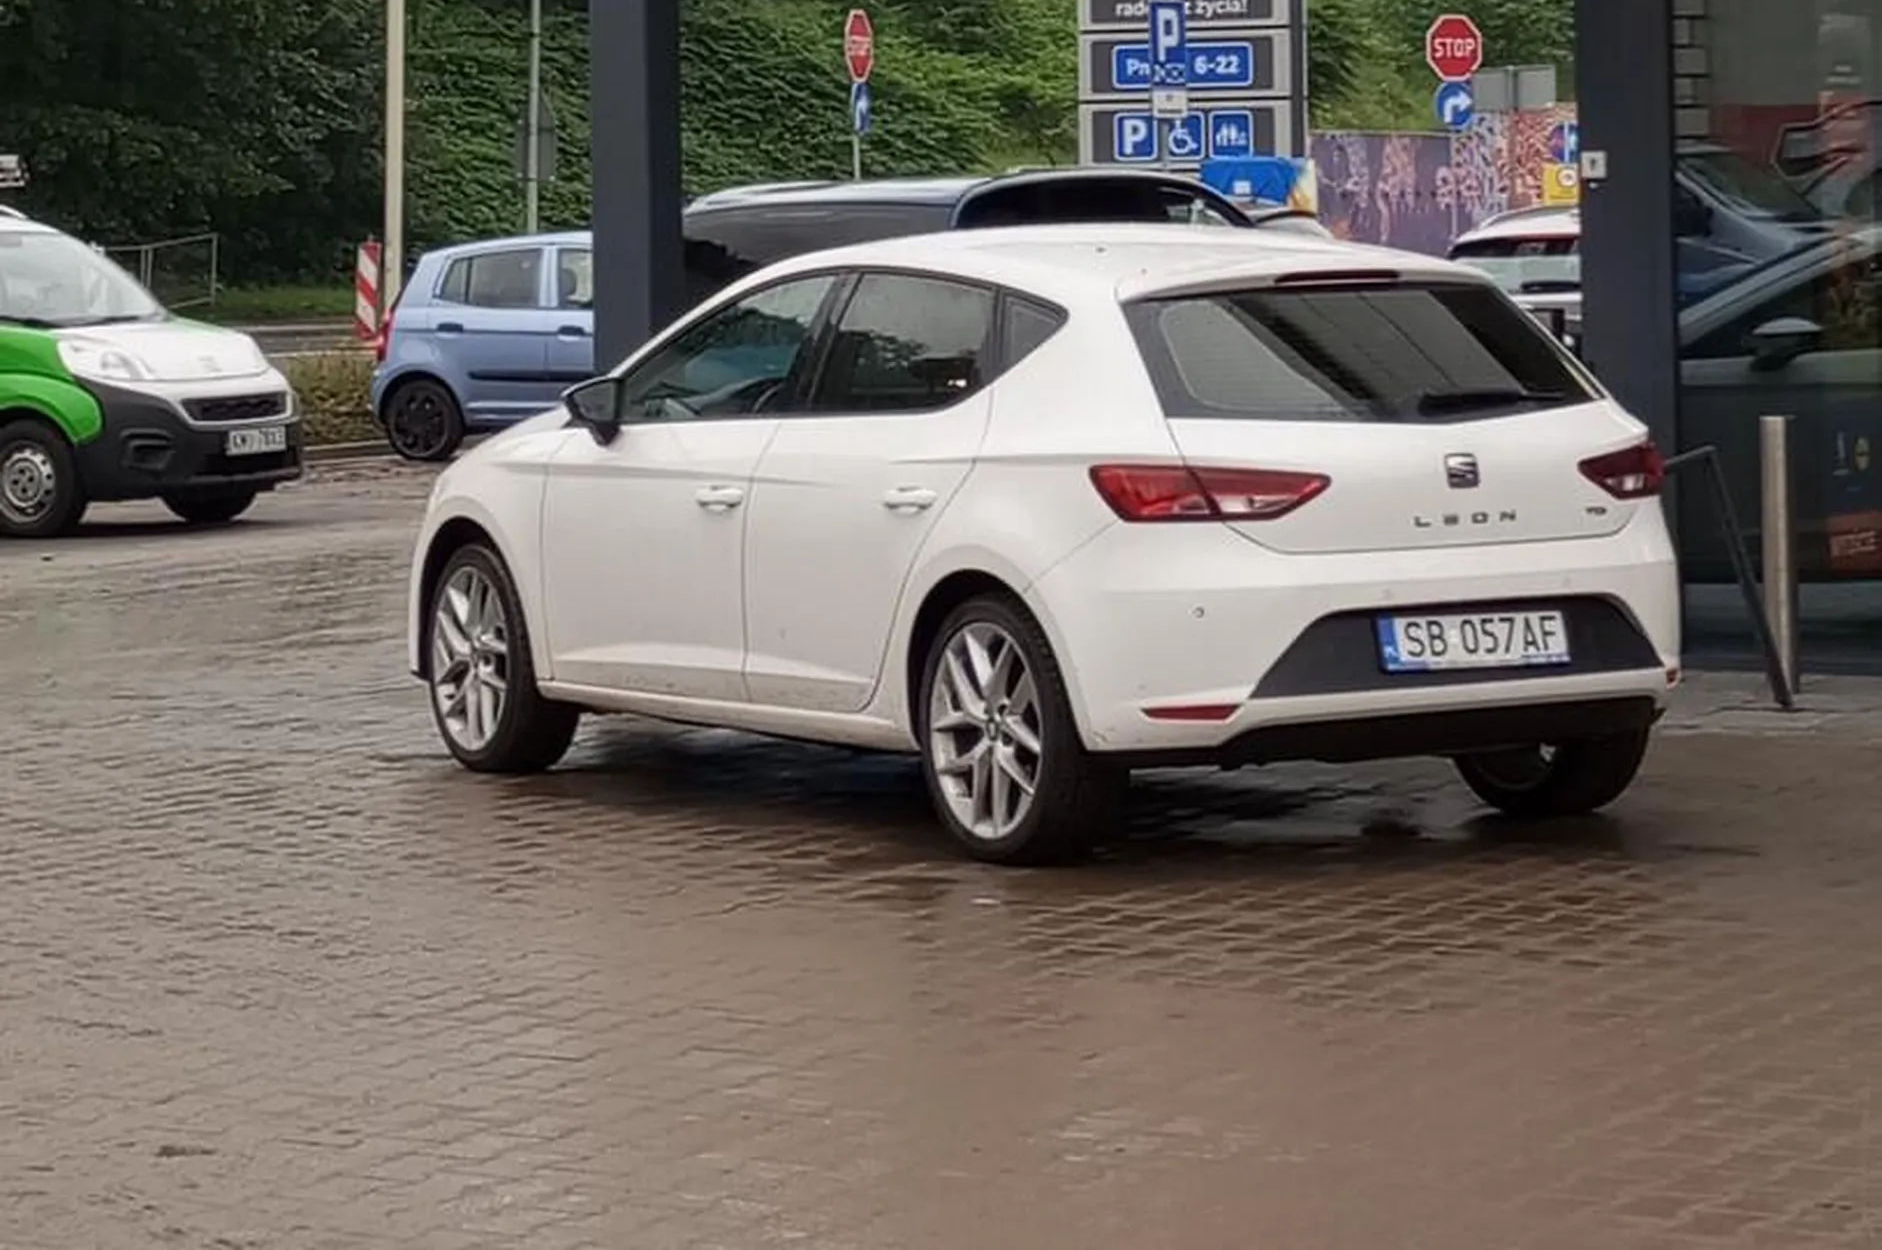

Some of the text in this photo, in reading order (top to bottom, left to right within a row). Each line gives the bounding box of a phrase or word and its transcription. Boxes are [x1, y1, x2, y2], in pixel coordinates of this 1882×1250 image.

[1156, 8, 1179, 62] P
[1433, 37, 1476, 59] STOP
[1194, 54, 1240, 76] 6-22
[1122, 118, 1148, 155] P
[1413, 509, 1517, 528] LEON
[1404, 615, 1557, 657] SB 057AF
